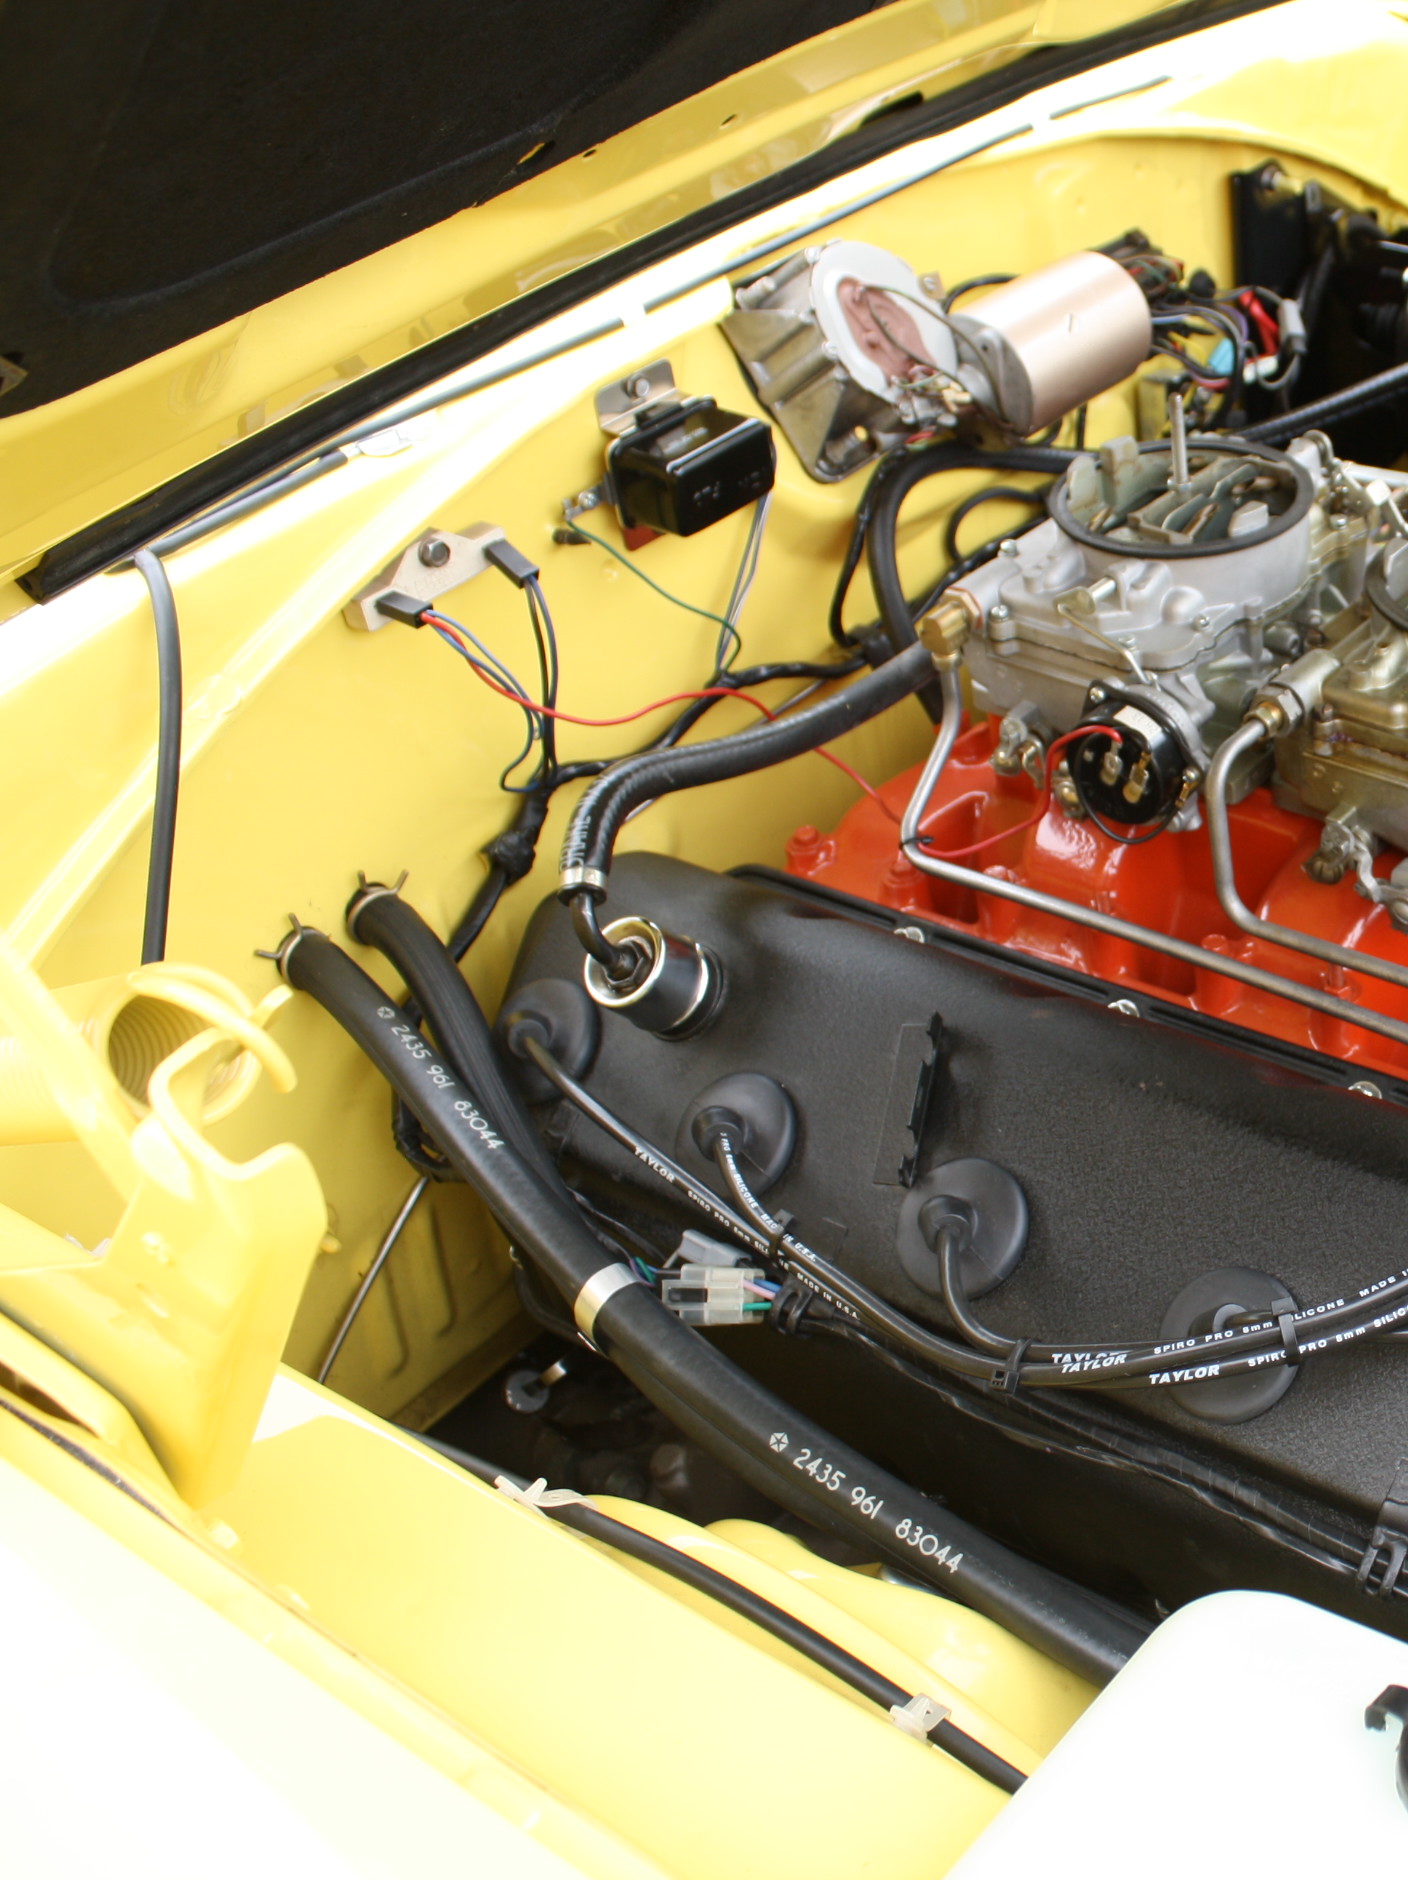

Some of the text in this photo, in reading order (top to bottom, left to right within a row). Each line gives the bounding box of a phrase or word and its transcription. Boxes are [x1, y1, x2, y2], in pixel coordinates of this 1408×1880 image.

[391, 1024, 505, 1149] 2435 961 83044
[634, 1146, 676, 1184] TAYLOR
[797, 1272, 820, 1293] MADE
[823, 1291, 832, 1302] IN
[760, 1213, 778, 1229] MAD
[1061, 1353, 1128, 1374] TAYLOR
[1153, 1338, 1196, 1355] SPIRO
[1205, 1329, 1234, 1343] PRO
[1242, 1321, 1273, 1334] 8mm
[1291, 1298, 1345, 1321] ILICONE
[1359, 1276, 1397, 1298] MADE
[1149, 1364, 1221, 1385] TAYLOR
[1298, 1338, 1327, 1354] PRO
[1335, 1327, 1366, 1343] 8mm
[793, 1448, 964, 1574] 2435 961 83044
